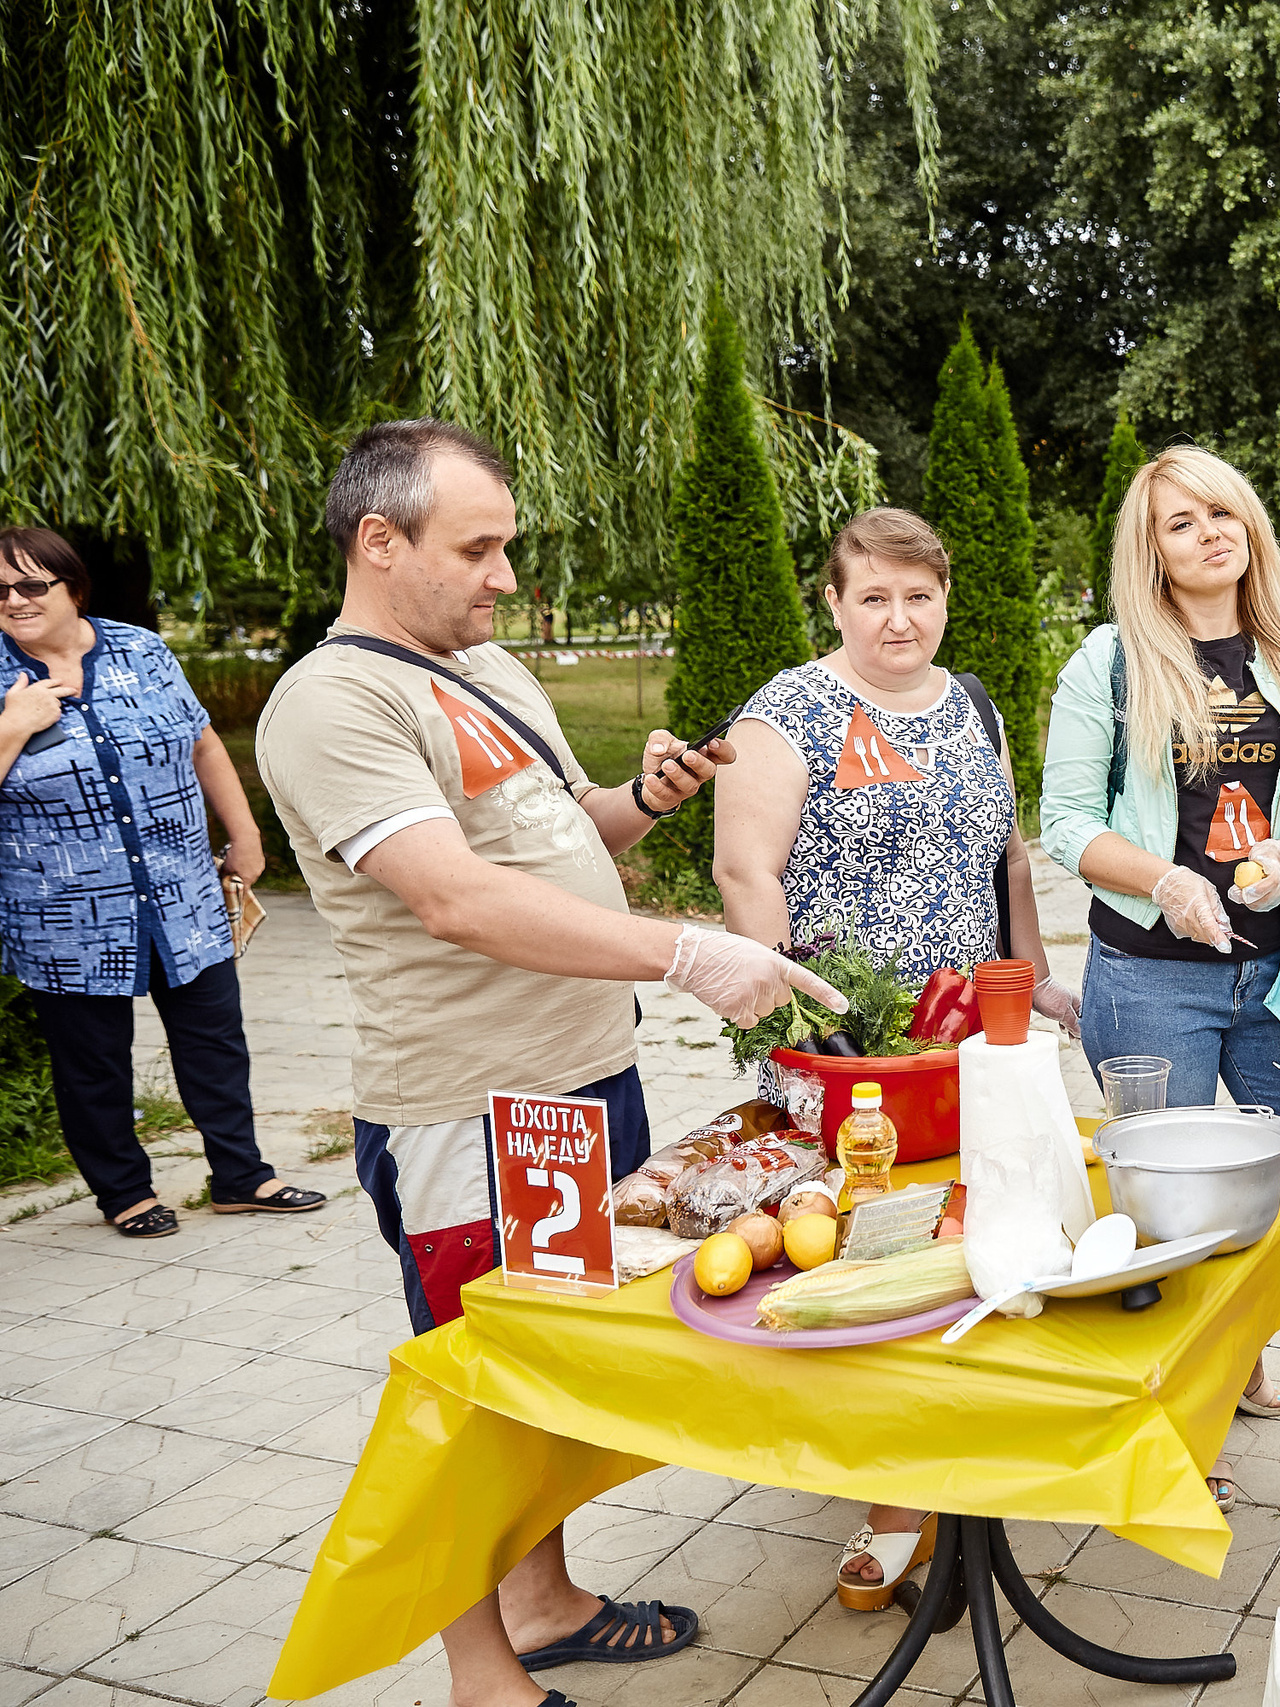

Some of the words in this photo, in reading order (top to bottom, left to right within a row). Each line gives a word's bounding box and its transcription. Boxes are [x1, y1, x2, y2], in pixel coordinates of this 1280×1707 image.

[510, 1102, 588, 1134] ОХОТА
[506, 1131, 538, 1159] НА
[543, 1134, 591, 1166] ЕДУ
[525, 1167, 586, 1276] 2
